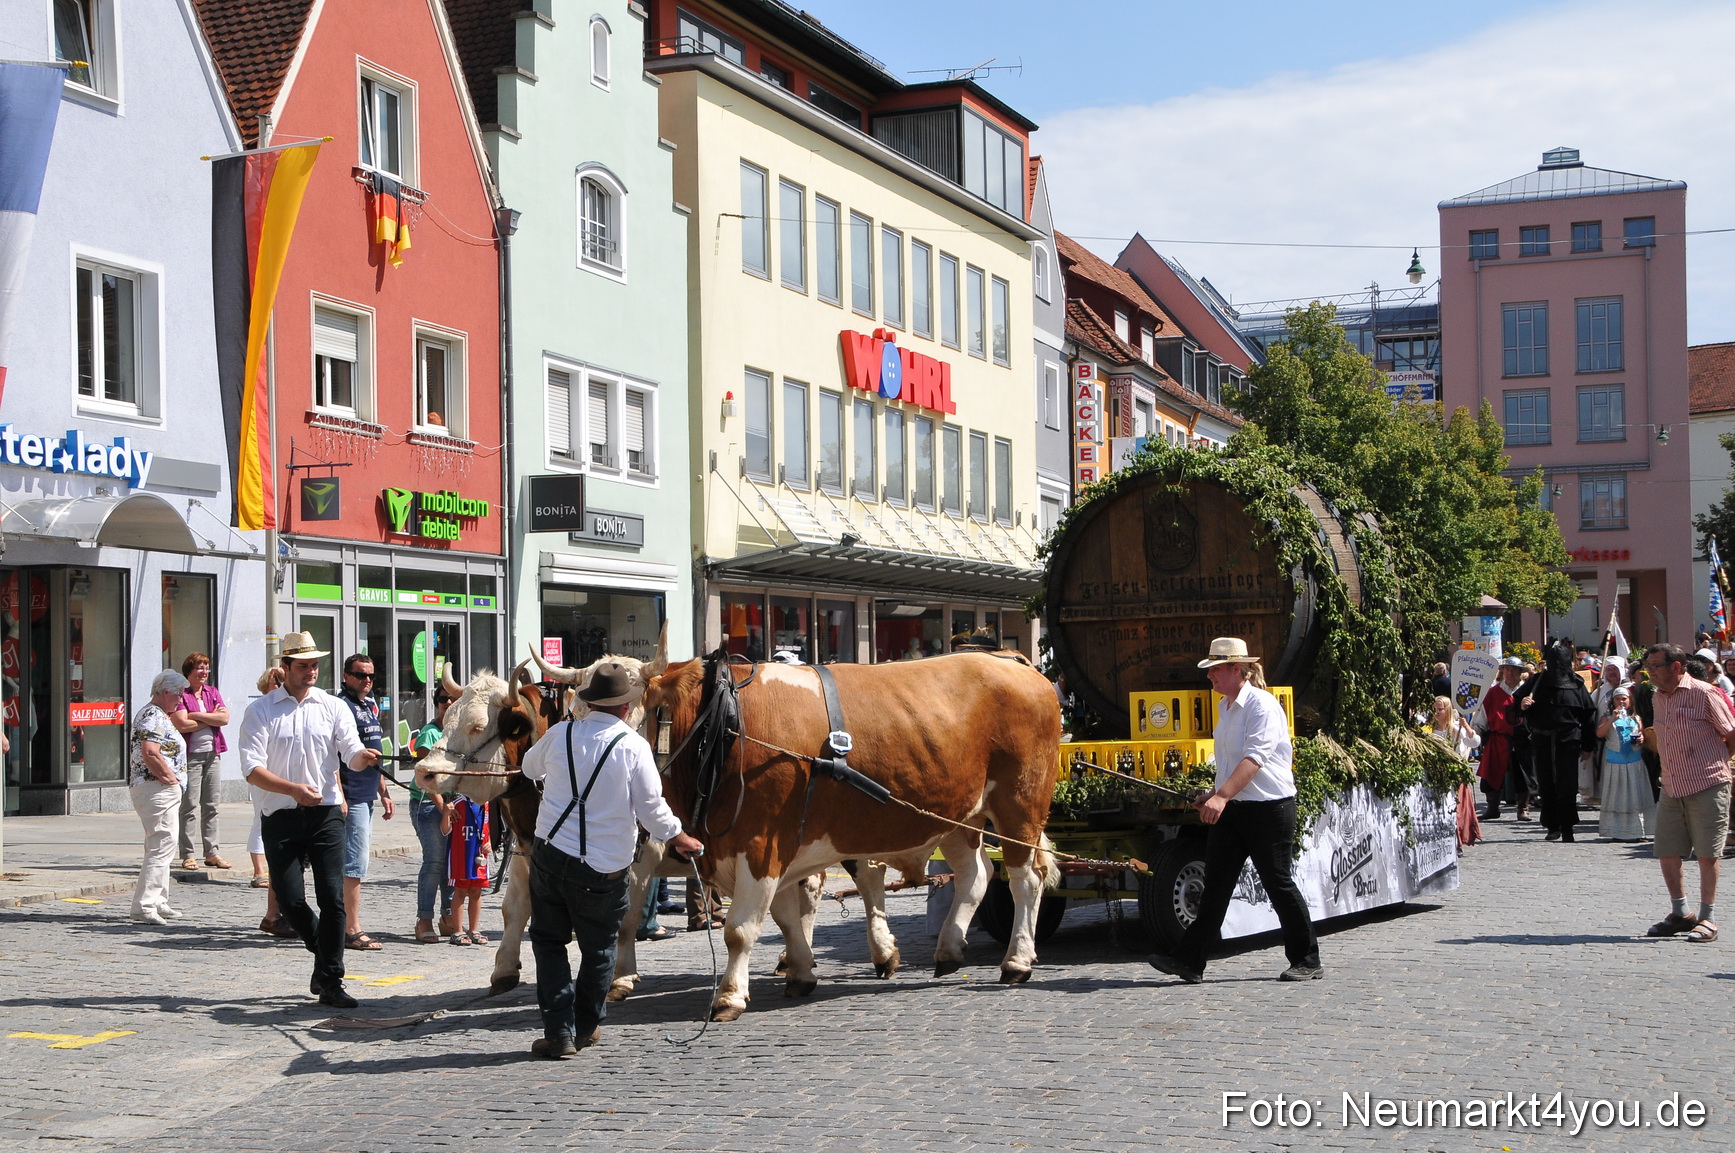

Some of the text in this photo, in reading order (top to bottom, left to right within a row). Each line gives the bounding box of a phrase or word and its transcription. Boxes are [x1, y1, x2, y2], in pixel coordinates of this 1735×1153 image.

[840, 327, 957, 416] WÖHRL
[0, 423, 154, 489] ter lady
[421, 489, 489, 517] mobilcom
[421, 515, 462, 541] debitel
[1566, 546, 1631, 561] rkasse
[359, 588, 389, 602] GRAVIS
[1189, 621, 1256, 638] Glossner
[71, 709, 91, 719] SALE
[92, 708, 118, 718] INSIDE
[1330, 834, 1373, 905] Glossner
[1353, 871, 1378, 898] Bräu
